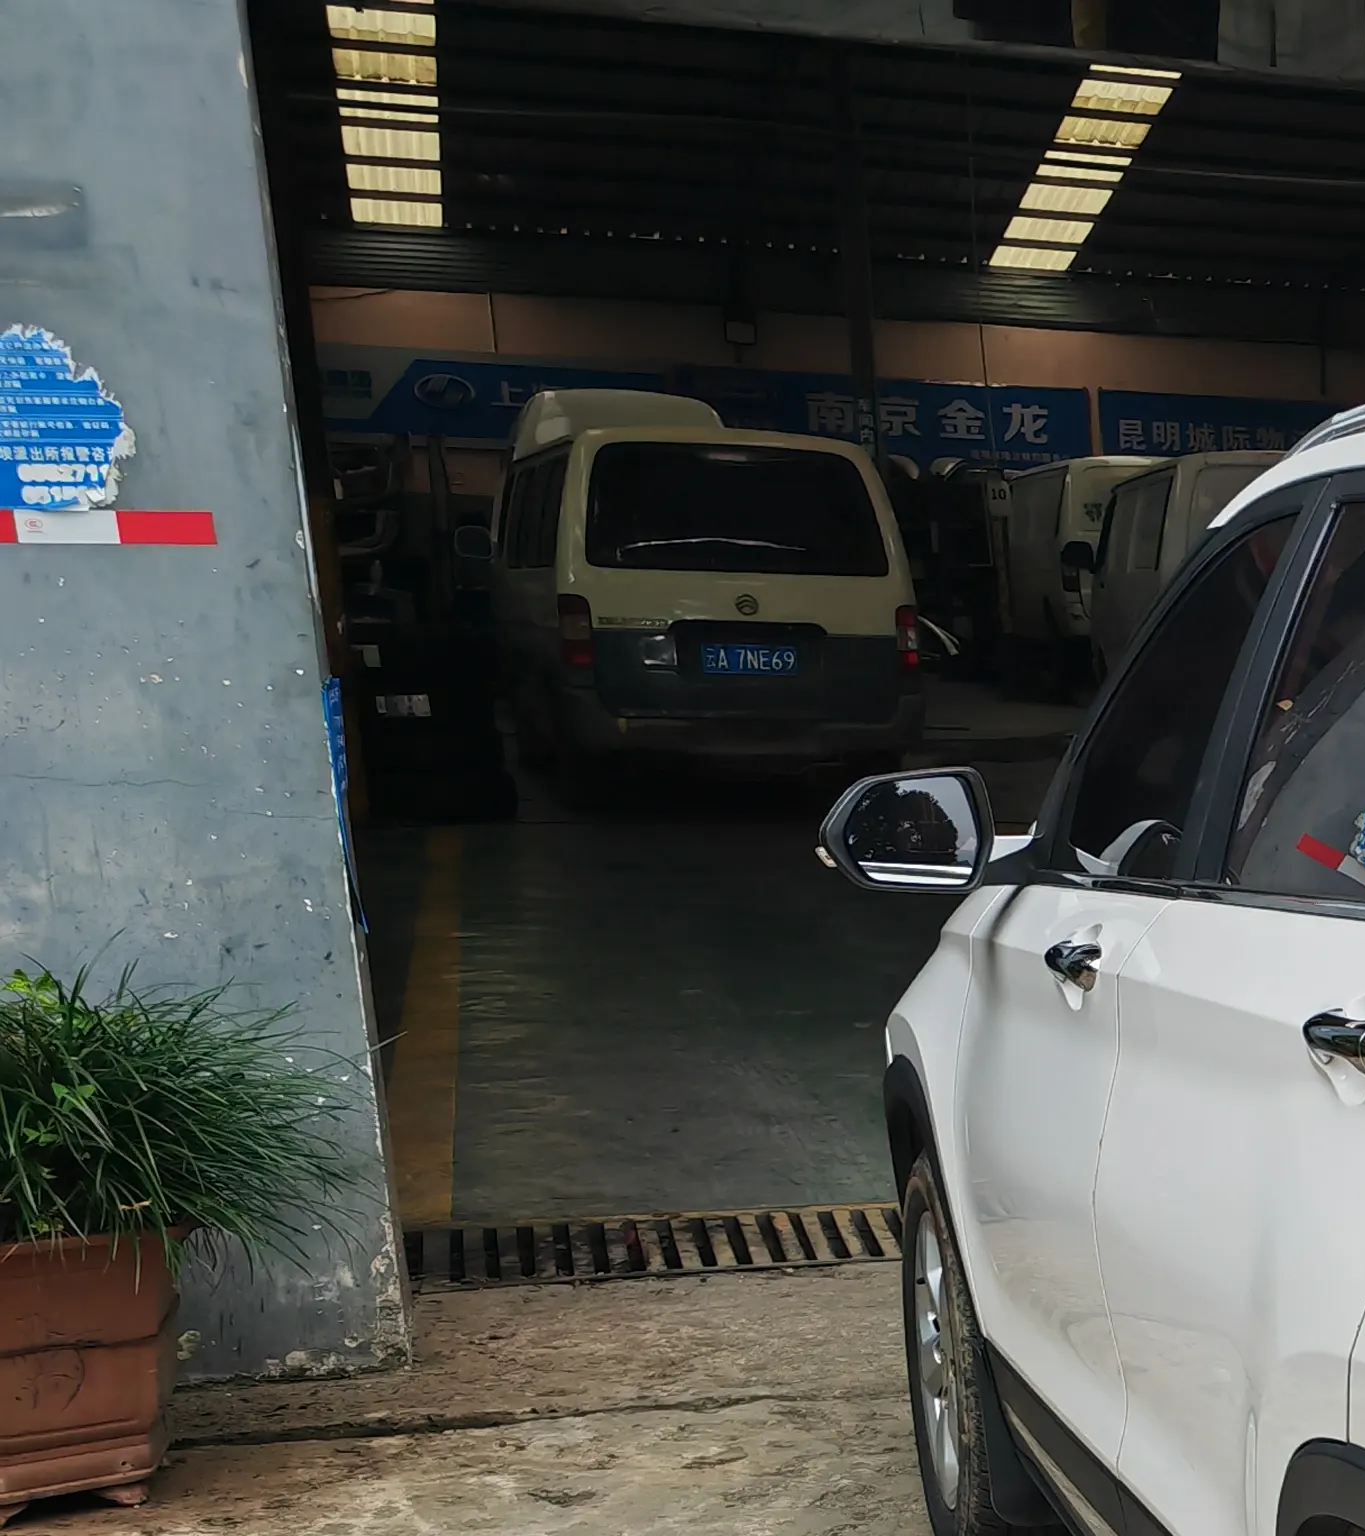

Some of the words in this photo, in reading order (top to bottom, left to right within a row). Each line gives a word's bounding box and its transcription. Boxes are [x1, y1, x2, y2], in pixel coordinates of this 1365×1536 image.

[805, 391, 1050, 445] 南京金龙
[991, 488, 1007, 500] 10
